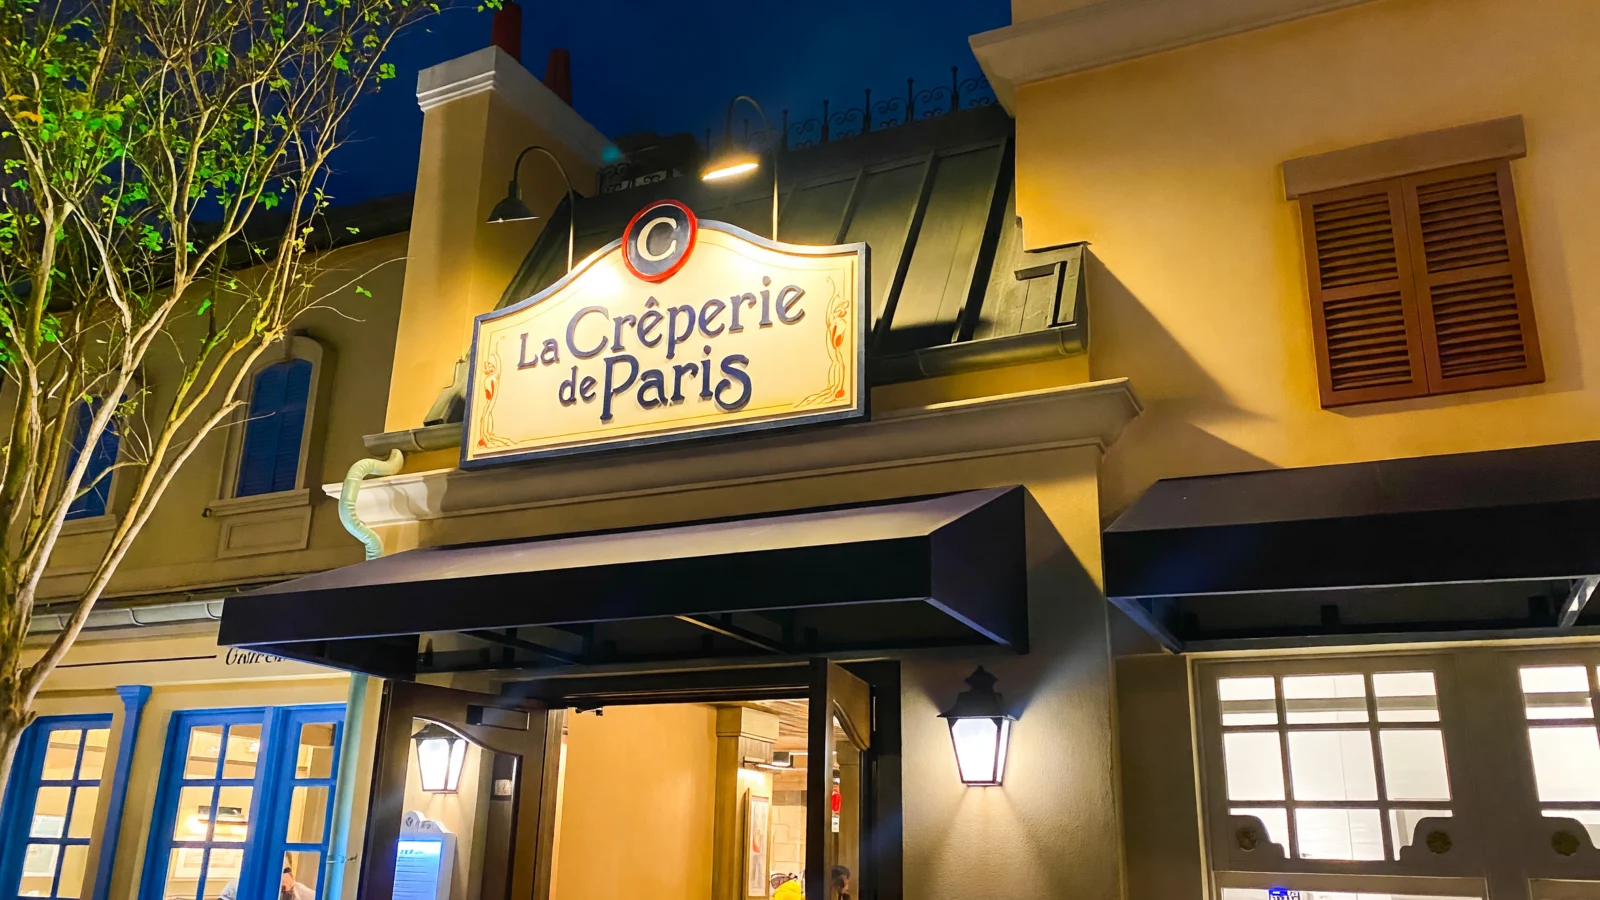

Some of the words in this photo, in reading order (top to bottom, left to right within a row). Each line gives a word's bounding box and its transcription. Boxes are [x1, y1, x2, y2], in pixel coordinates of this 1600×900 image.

[636, 216, 678, 262] C
[517, 333, 560, 370] La
[566, 276, 806, 360] Crêperie
[558, 365, 597, 407] de
[600, 345, 753, 422] Paris
